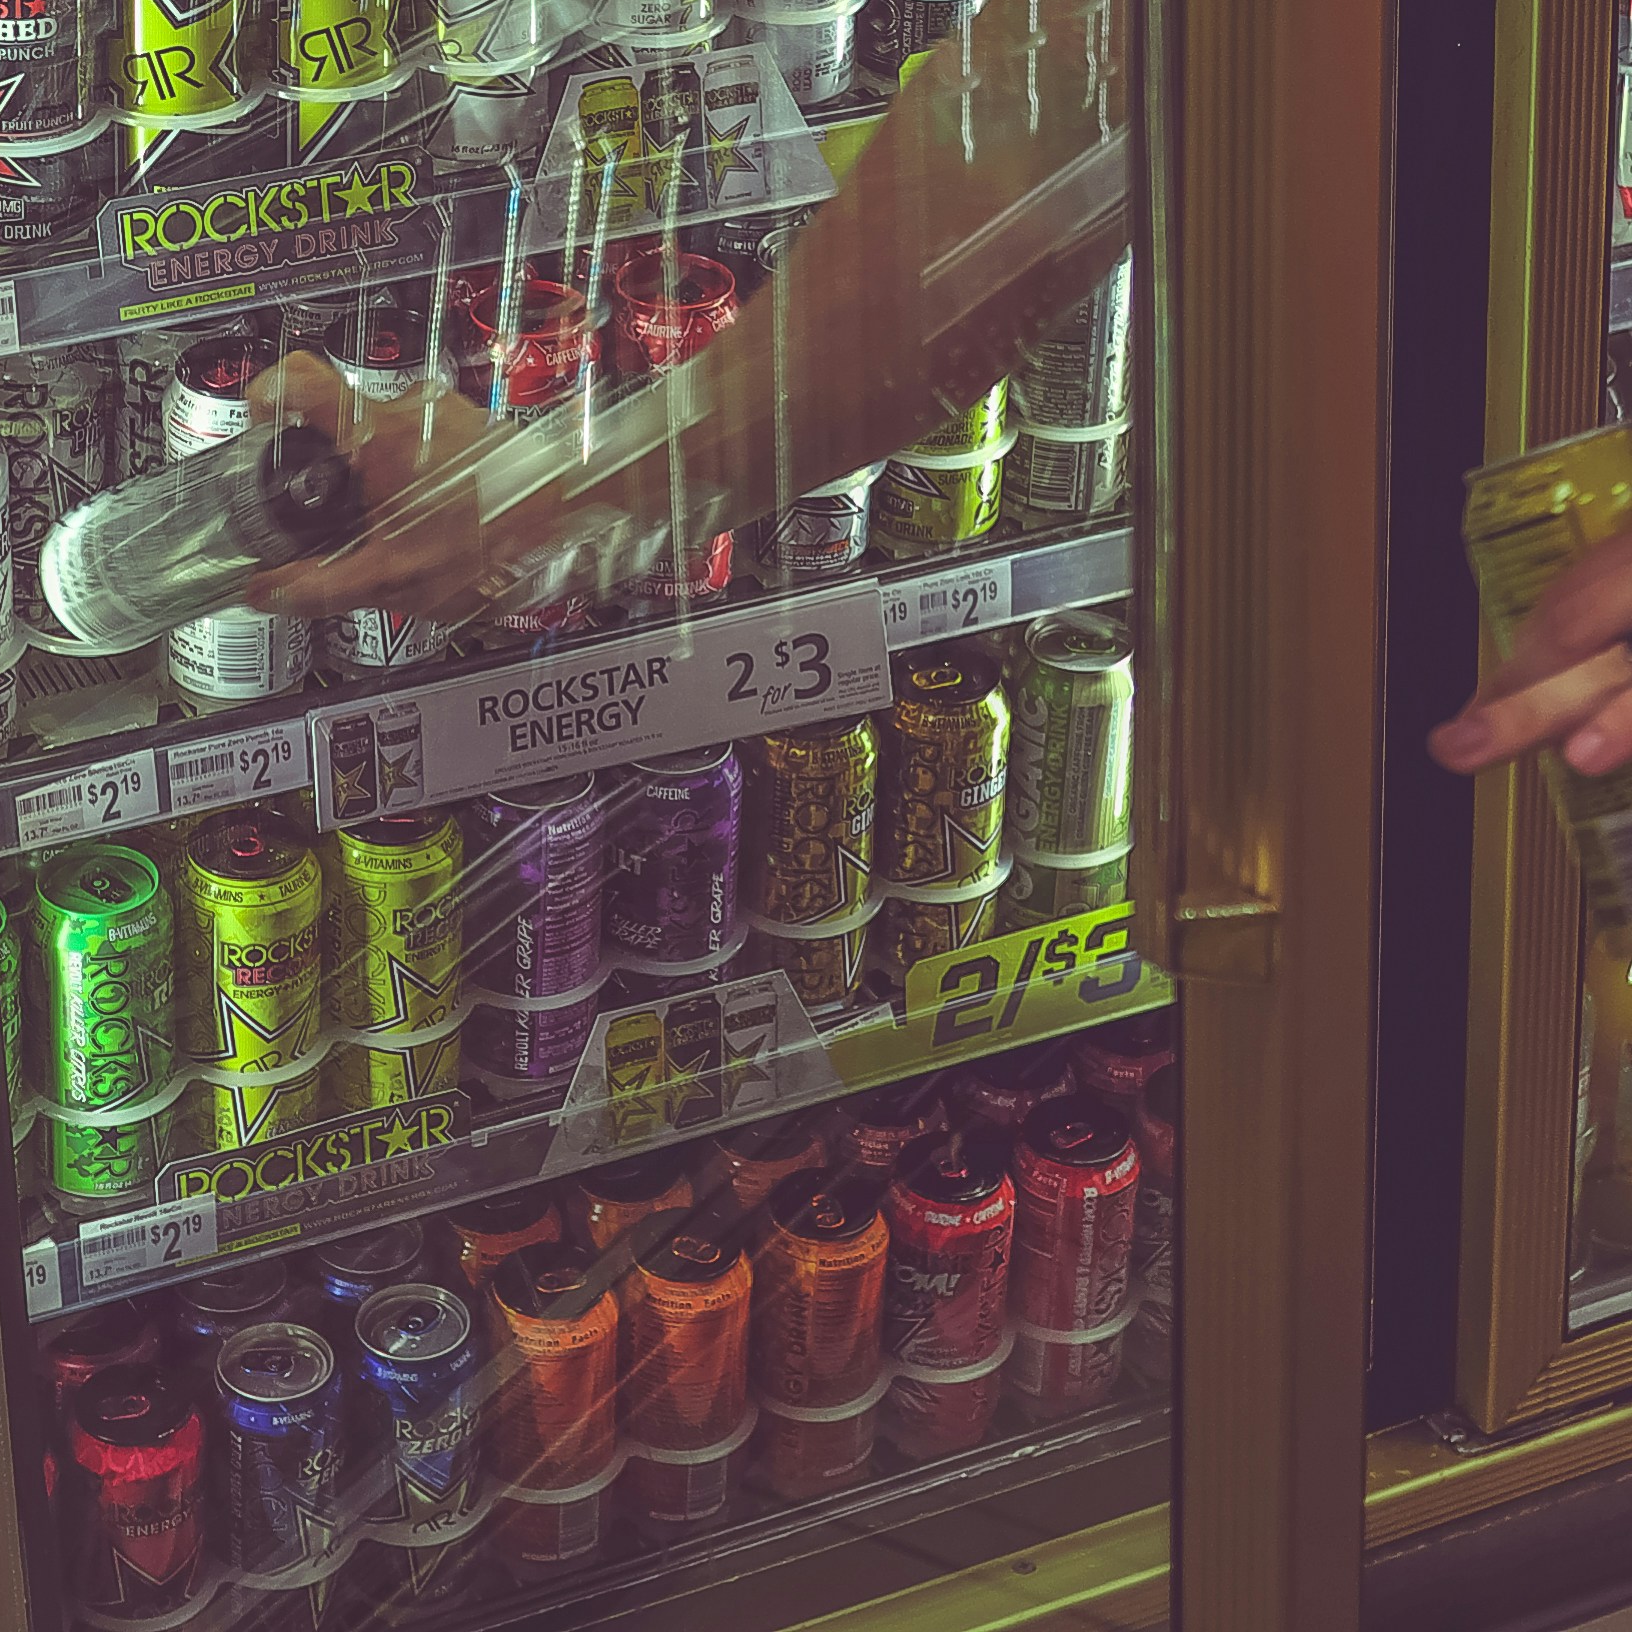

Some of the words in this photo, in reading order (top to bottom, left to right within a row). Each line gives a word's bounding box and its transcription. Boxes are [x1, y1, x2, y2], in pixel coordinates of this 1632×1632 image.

[4, 222, 52, 239] DRINK
[149, 239, 280, 289] ENERGY
[294, 216, 399, 258] DRINK
[477, 656, 669, 726] ROCKSTAR
[726, 652, 758, 703] 2
[508, 695, 647, 753] ENERGY
